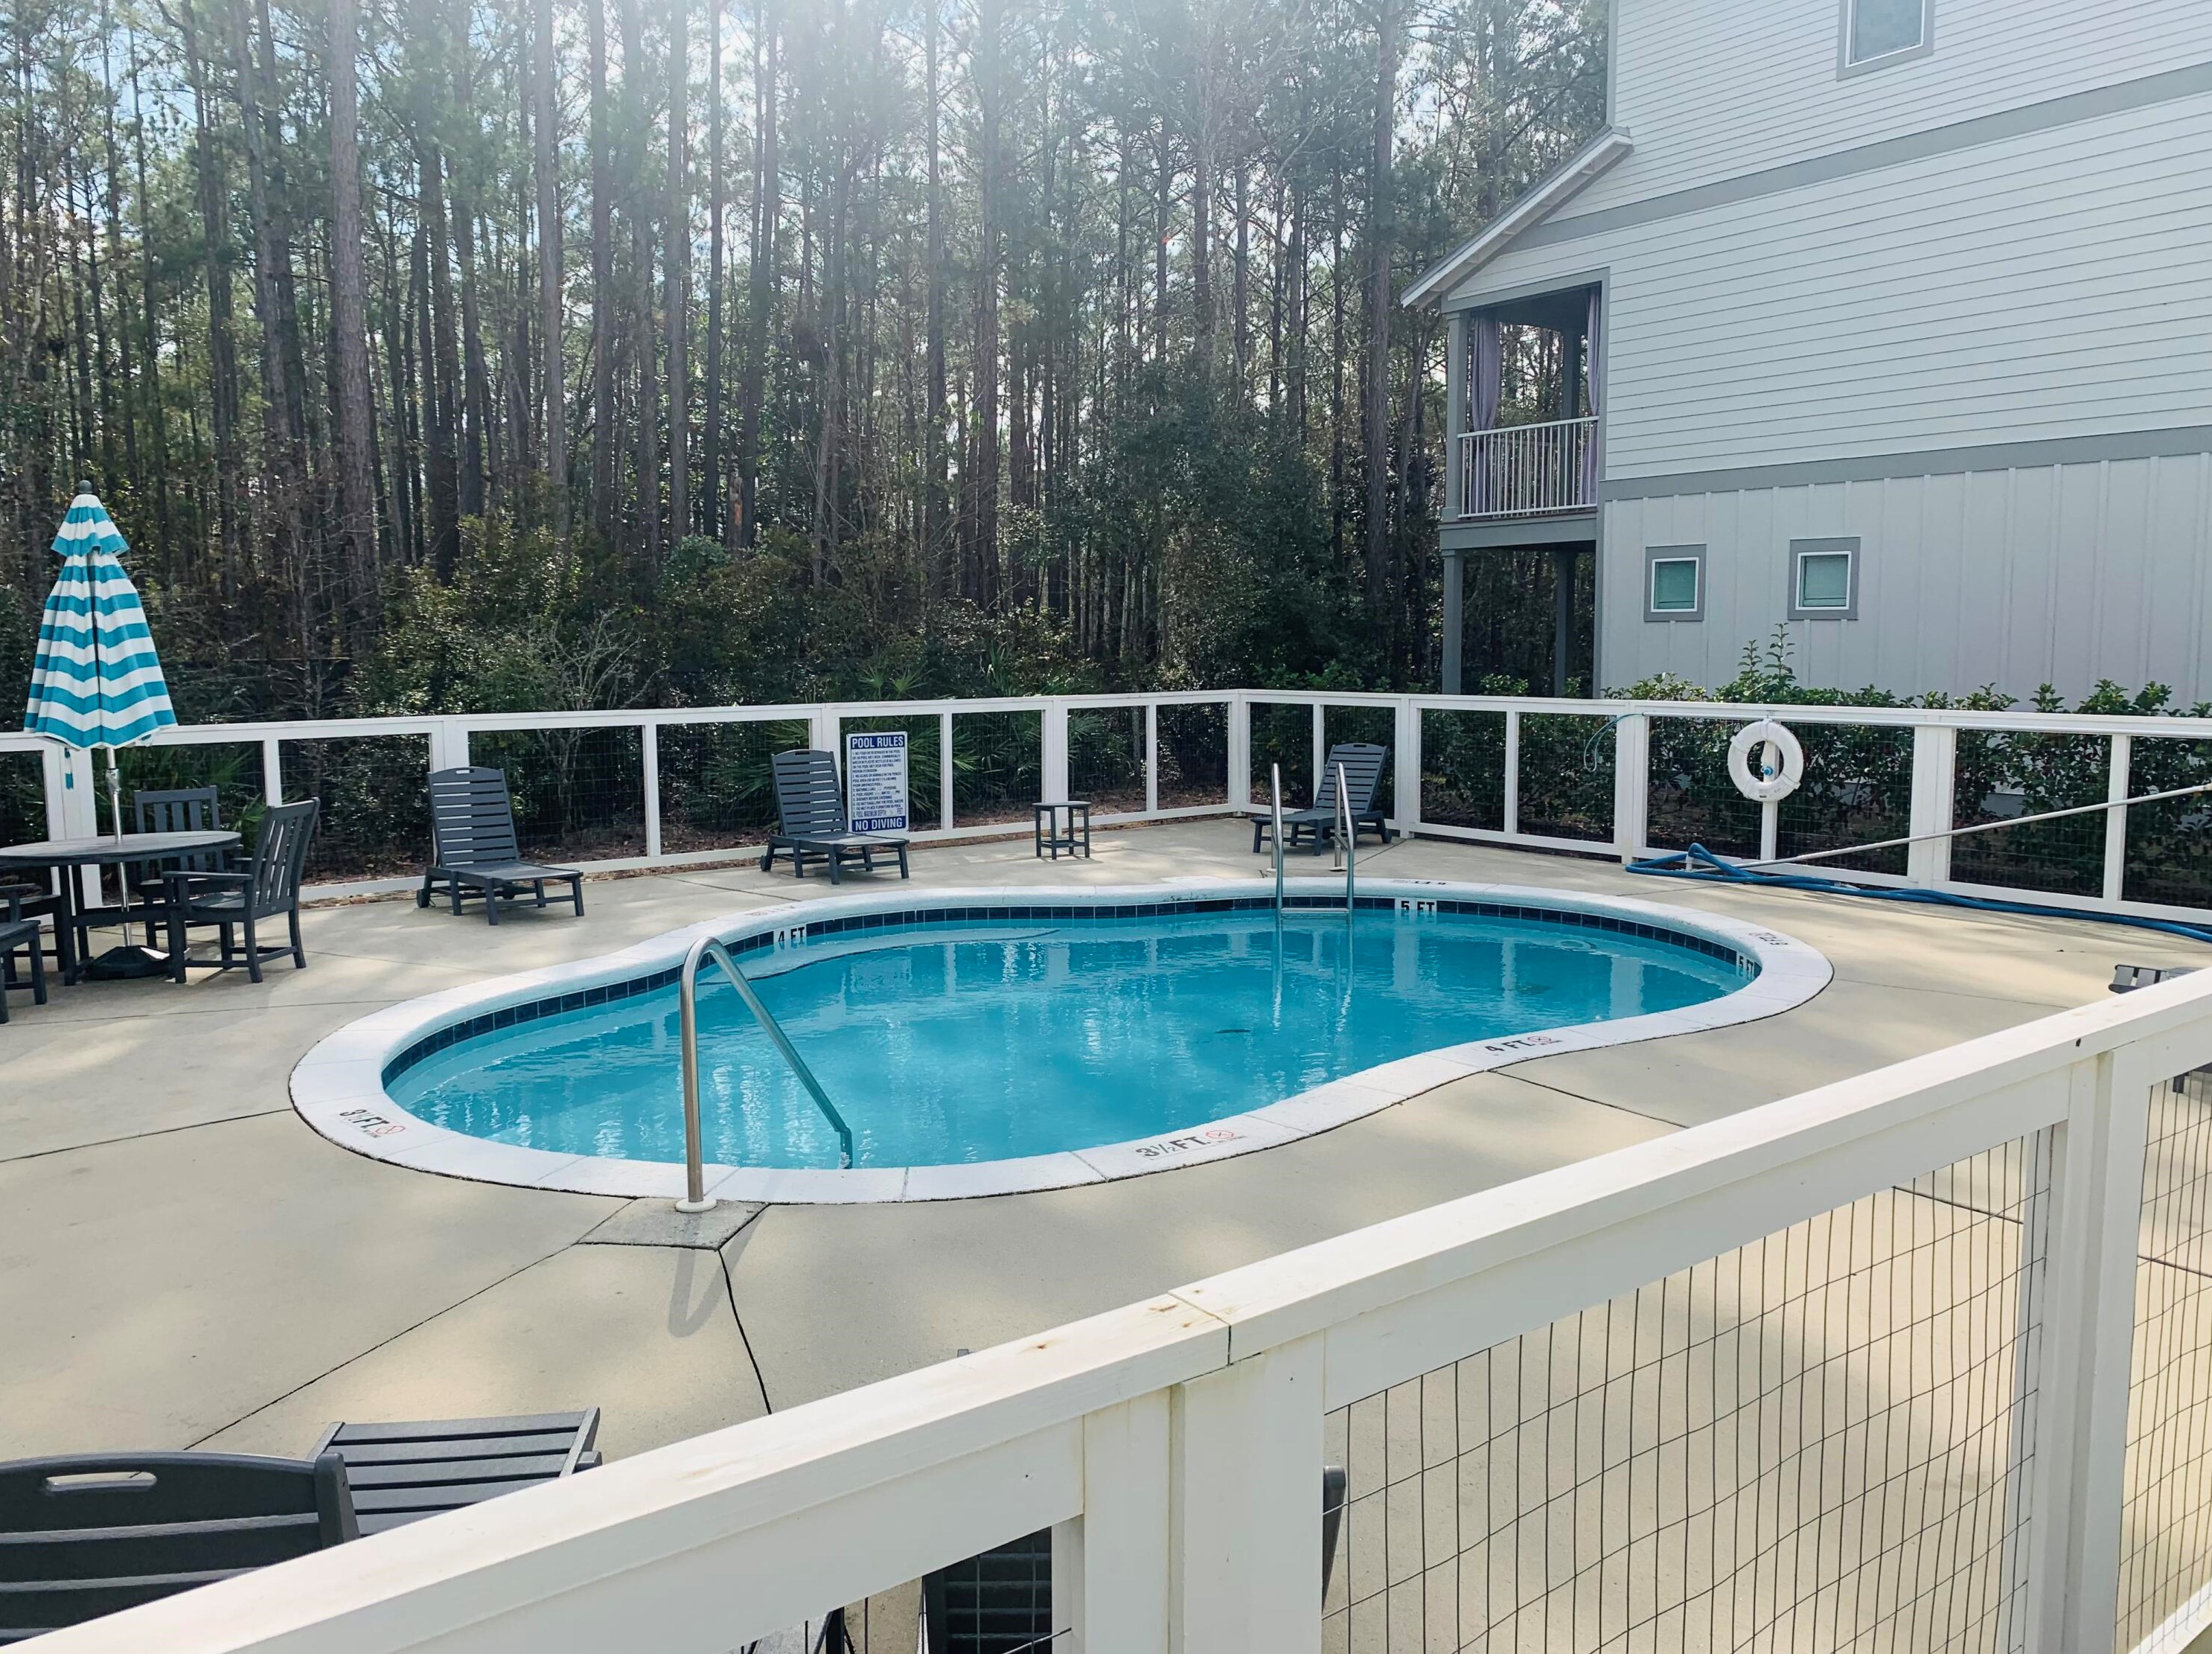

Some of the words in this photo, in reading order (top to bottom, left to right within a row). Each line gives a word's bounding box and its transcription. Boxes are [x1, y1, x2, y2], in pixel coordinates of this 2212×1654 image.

[852, 737, 875, 748] POOL
[877, 735, 904, 747] RULES
[855, 820, 869, 831] NO
[872, 817, 903, 829] DIVING
[1401, 900, 1410, 911] 5
[1416, 901, 1435, 912] FT
[778, 930, 784, 942] 4
[790, 926, 805, 939] FT
